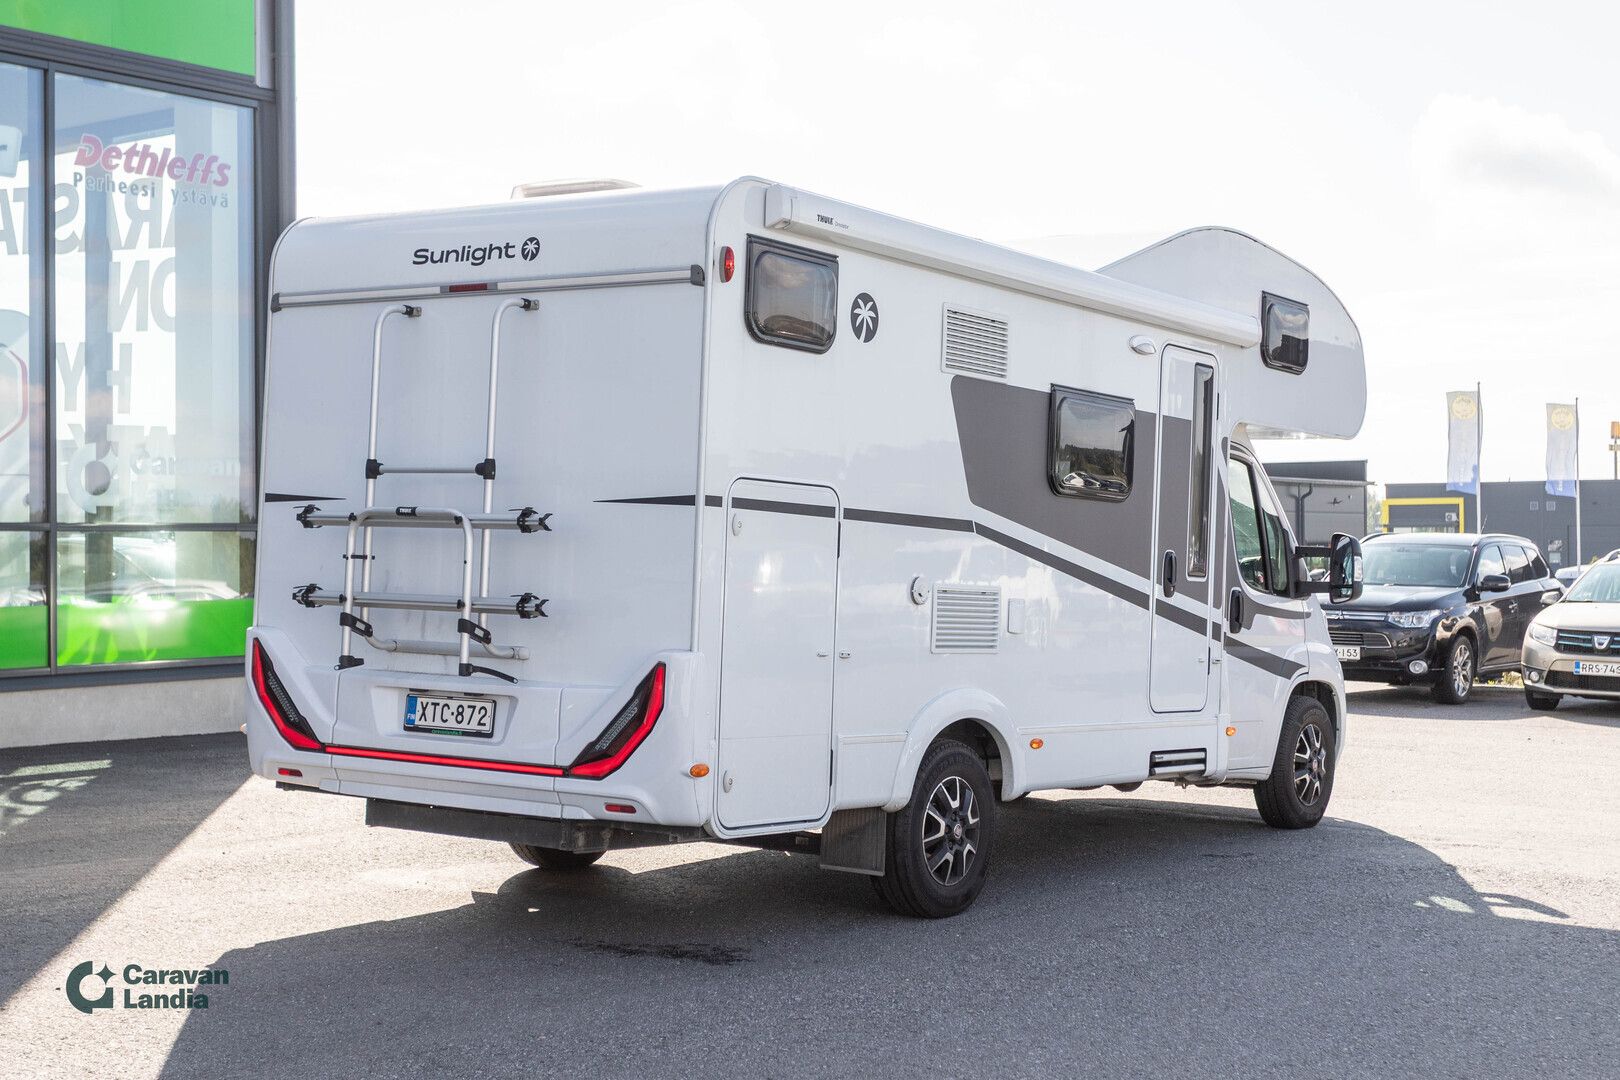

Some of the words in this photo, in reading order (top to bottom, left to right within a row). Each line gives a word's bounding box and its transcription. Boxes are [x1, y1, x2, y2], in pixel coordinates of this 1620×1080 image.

[74, 134, 231, 187] Dethleffs
[73, 172, 155, 198] Perheesi
[171, 188, 228, 208] ystävä
[413, 242, 516, 266] Sunlight
[418, 701, 488, 727] XTC-872
